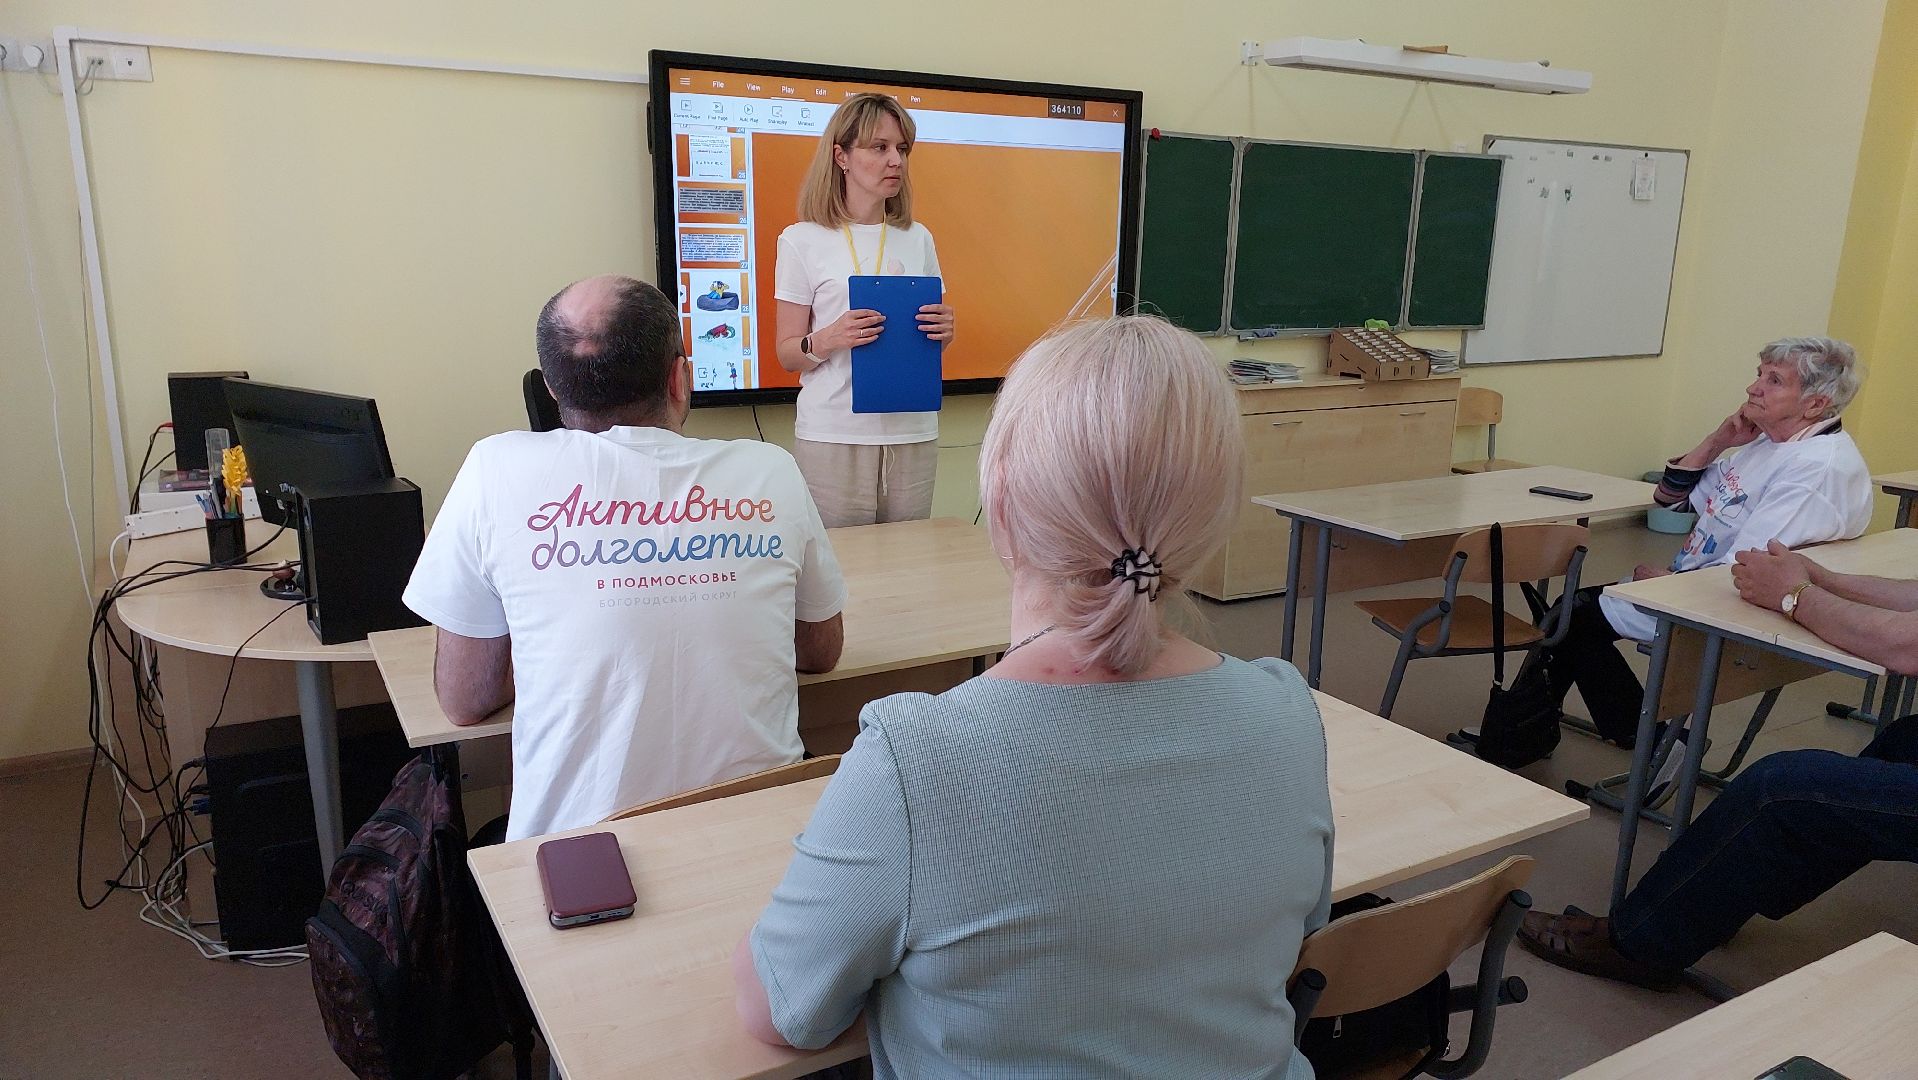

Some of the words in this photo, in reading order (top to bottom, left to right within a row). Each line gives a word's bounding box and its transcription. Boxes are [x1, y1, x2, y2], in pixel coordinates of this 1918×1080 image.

[712, 80, 725, 89] File
[746, 83, 761, 92] View
[781, 85, 795, 95] Play
[815, 88, 827, 97] Edit
[910, 95, 921, 103] Pen
[1051, 104, 1082, 115] 364110
[527, 483, 776, 532] Активное
[531, 525, 784, 571] долголетие
[597, 579, 606, 589] В
[612, 571, 737, 589] ПОДМОСКОВЬЕ
[599, 592, 698, 608] БОГОРОДСКИЙ
[701, 590, 738, 601] ОКРУГ
